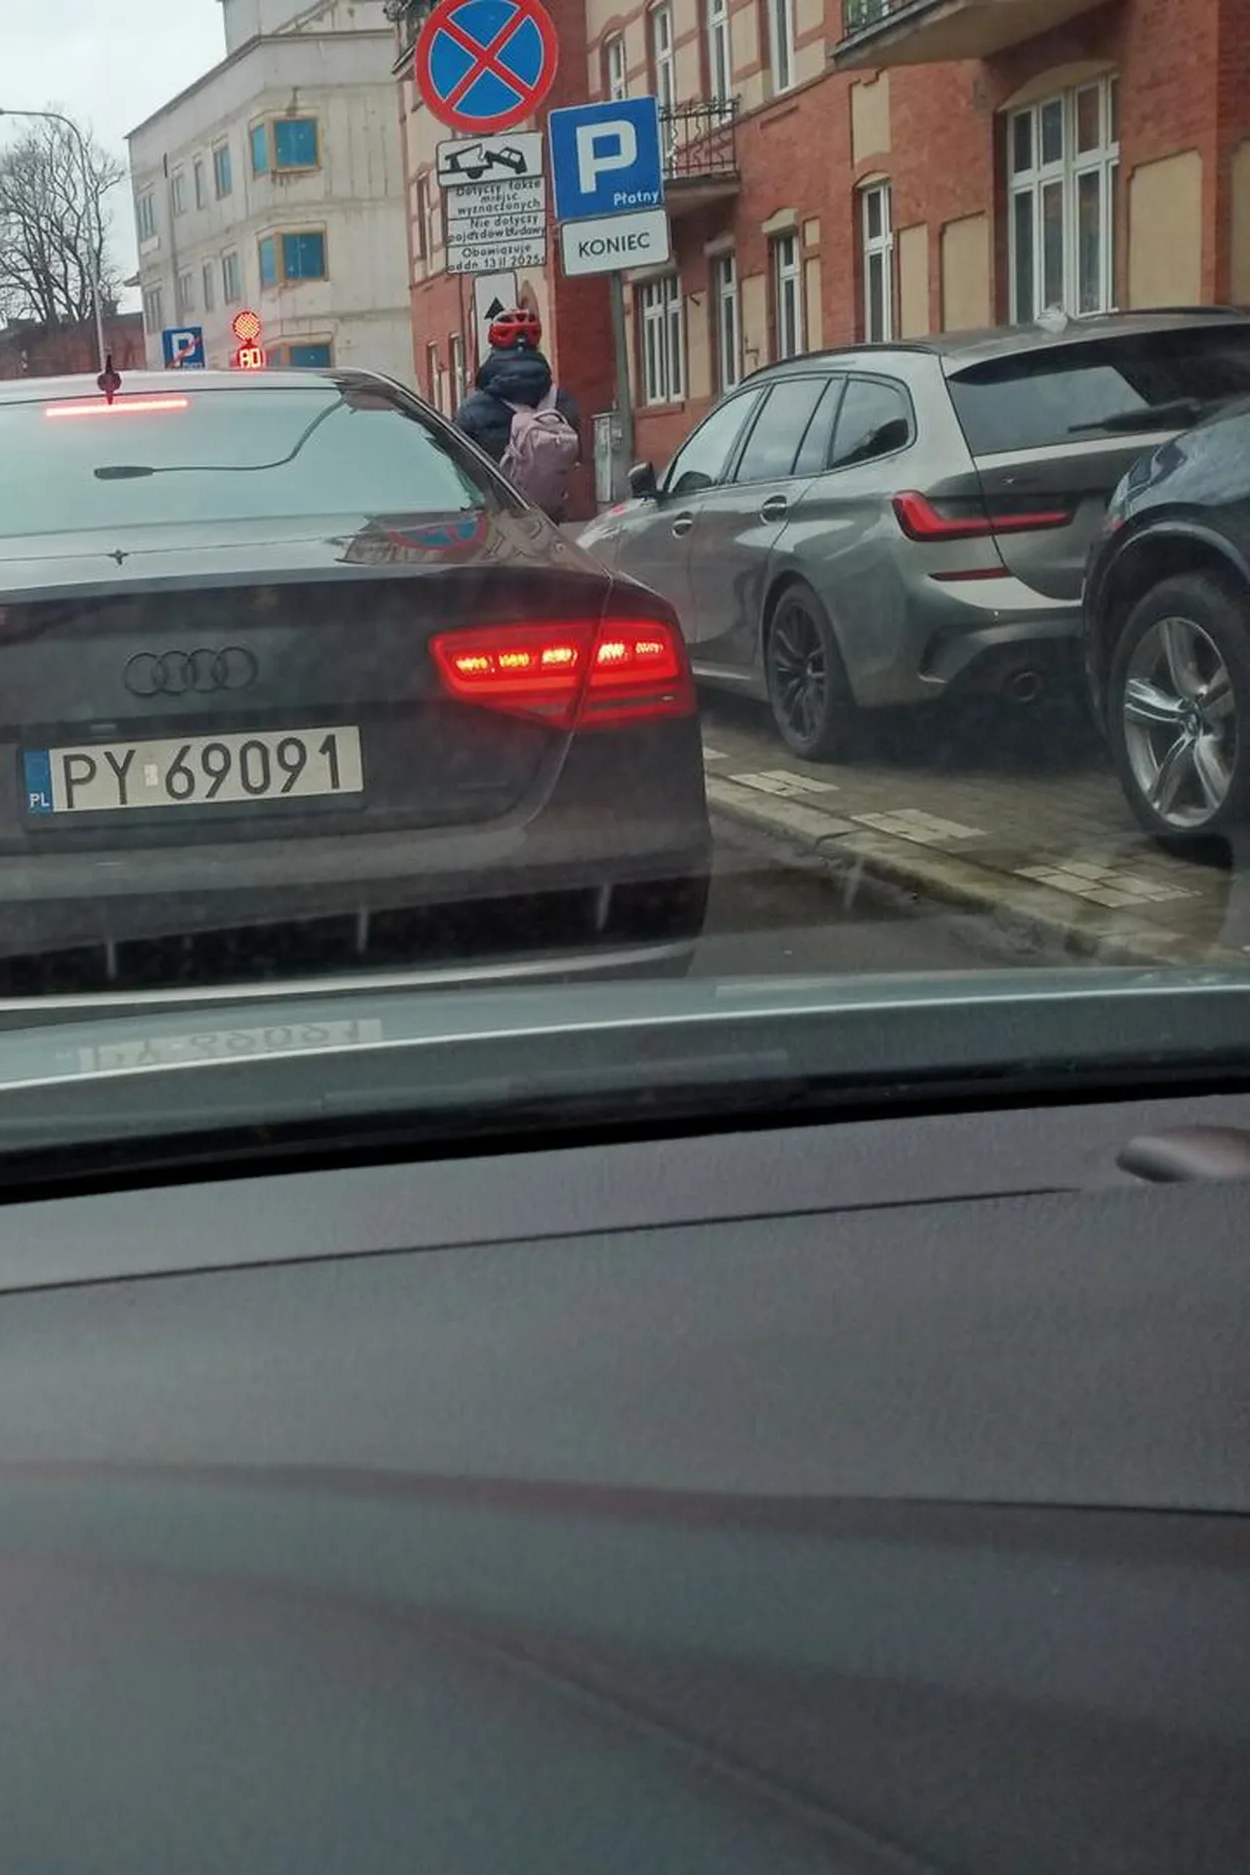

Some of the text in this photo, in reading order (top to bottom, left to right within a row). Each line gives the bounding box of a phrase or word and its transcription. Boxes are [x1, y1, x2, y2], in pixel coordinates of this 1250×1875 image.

[576, 120, 637, 194] P
[494, 214, 538, 227] dotyczy
[578, 232, 651, 258] KONIEC
[171, 332, 196, 367] P
[62, 734, 340, 808] PY 69091
[29, 792, 50, 808] PL
